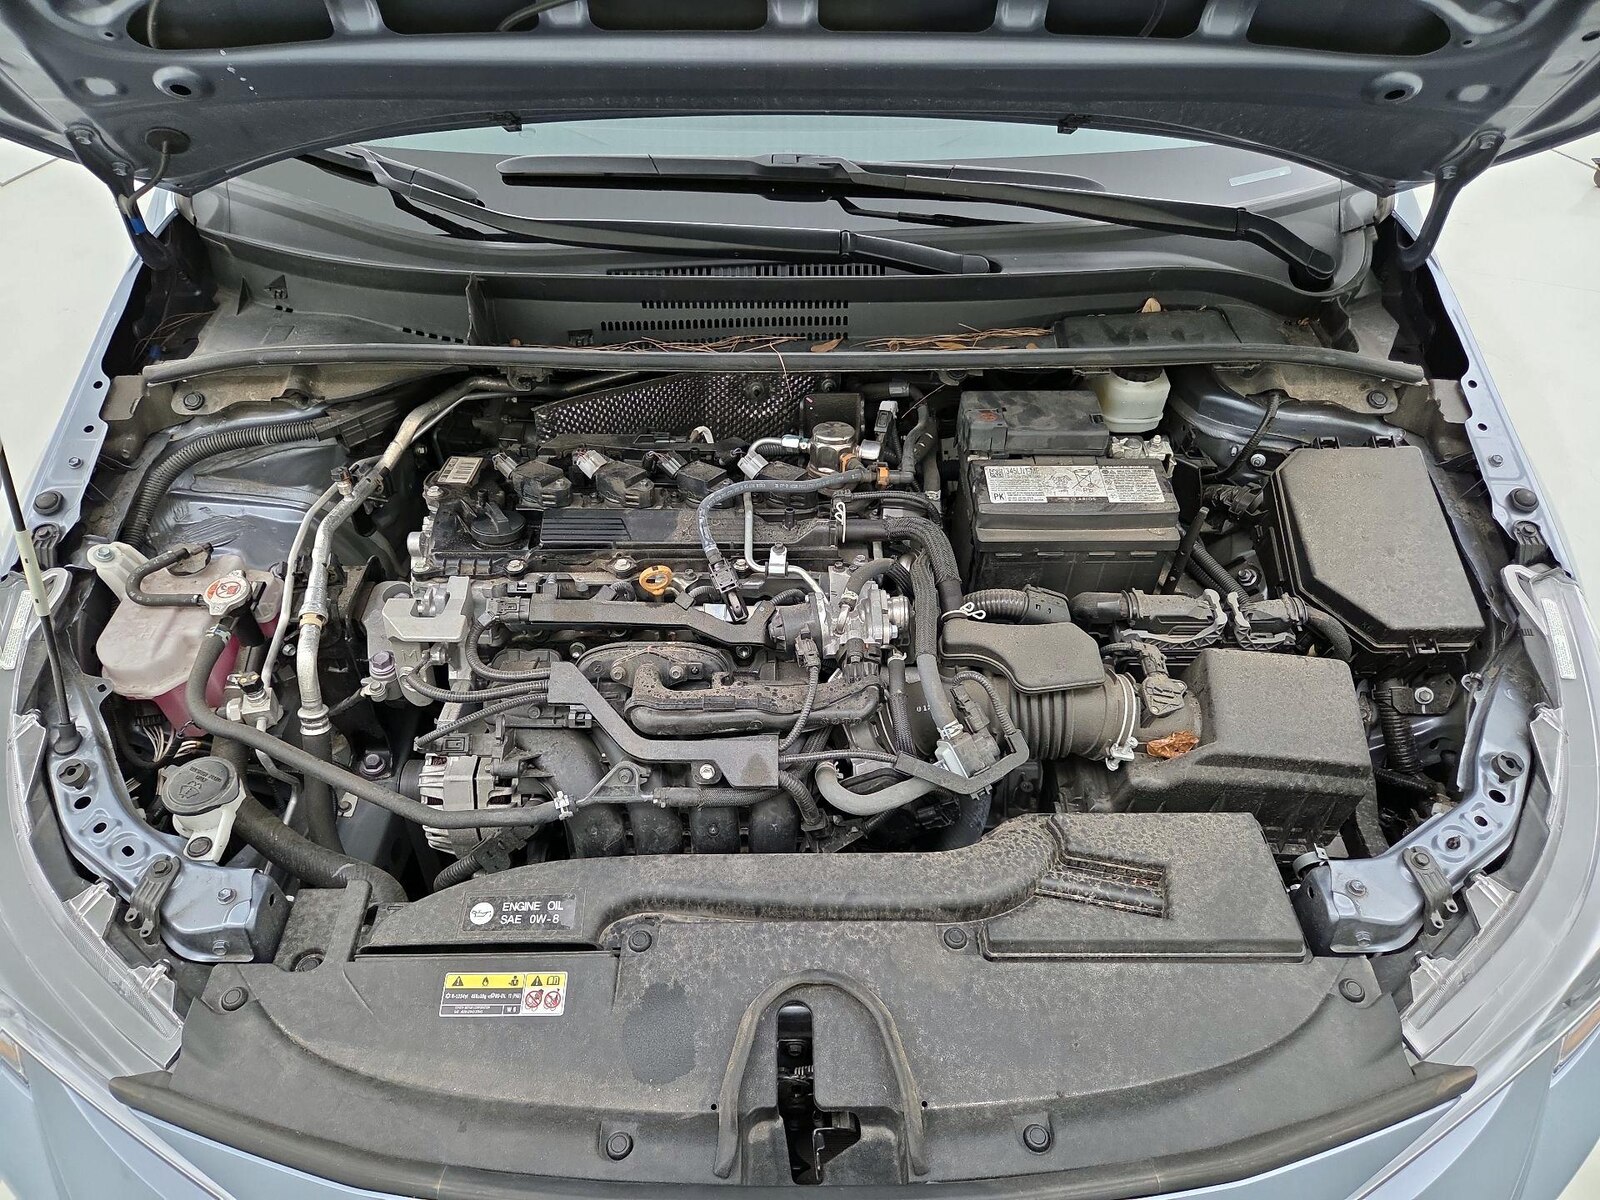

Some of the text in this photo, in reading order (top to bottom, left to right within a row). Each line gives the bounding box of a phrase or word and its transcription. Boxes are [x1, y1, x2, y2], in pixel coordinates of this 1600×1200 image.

[993, 493, 1005, 501] PK
[502, 900, 564, 912] ENGINE OIL
[500, 913, 560, 924] SAE 0W-8
